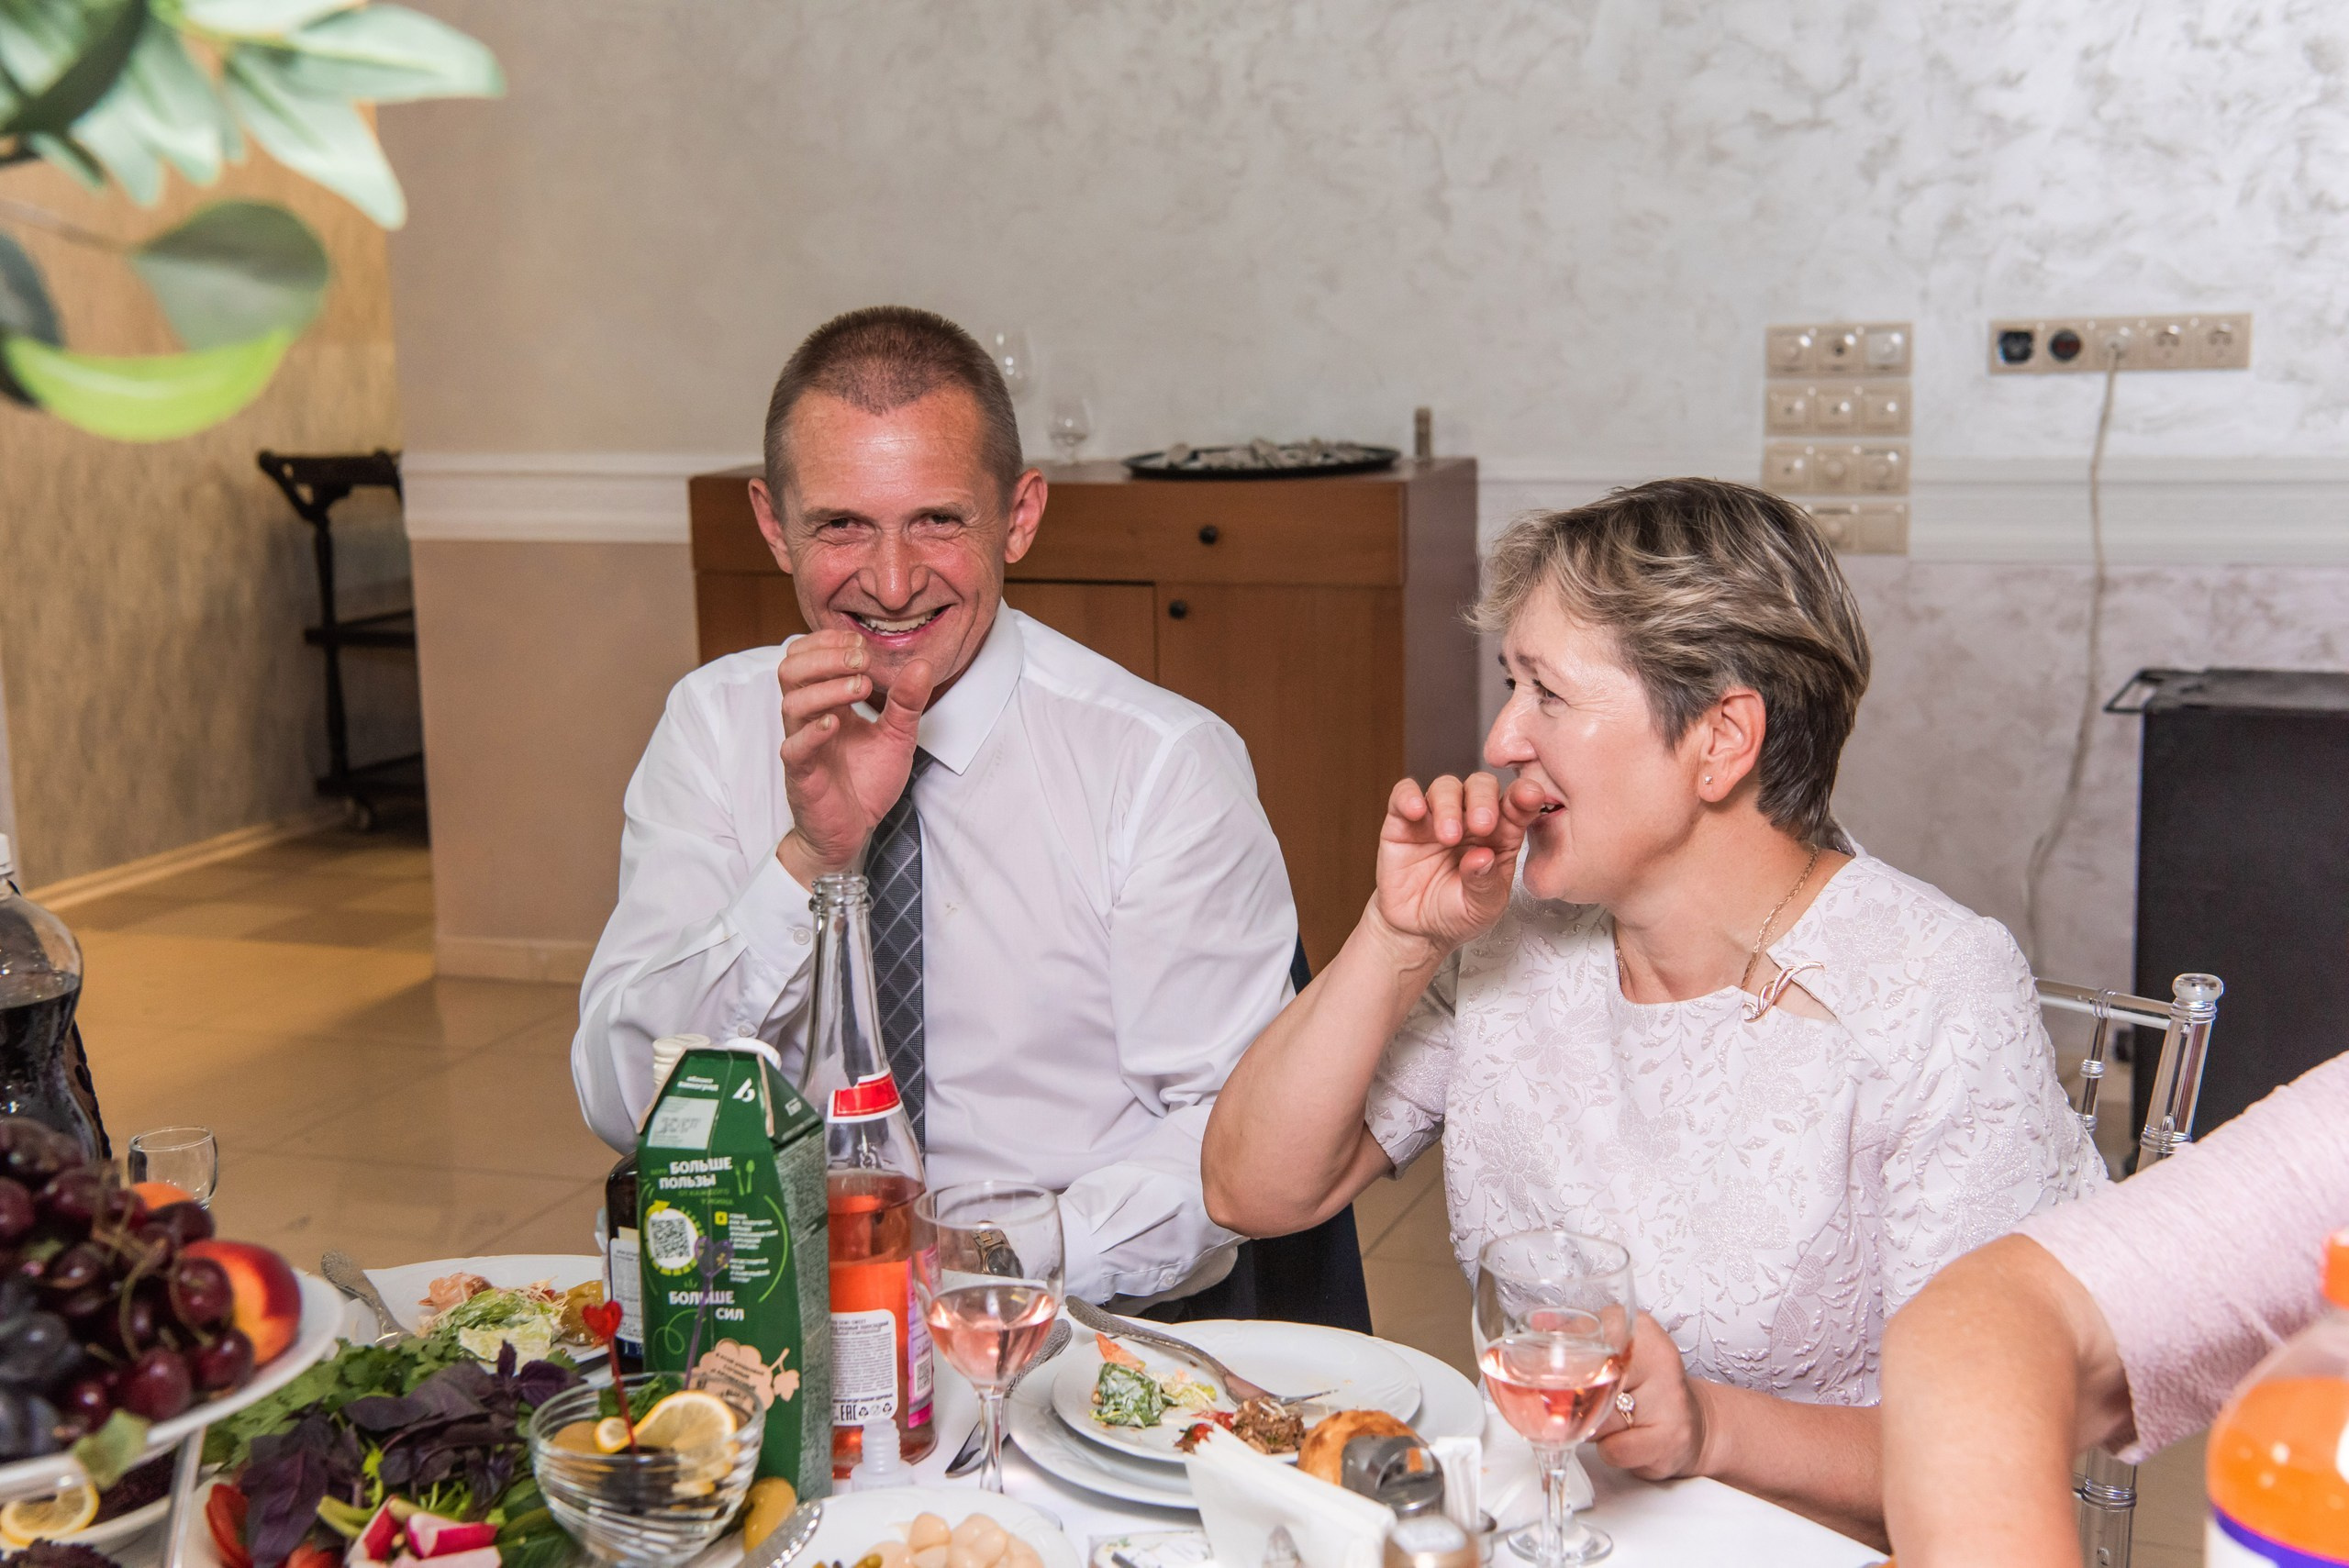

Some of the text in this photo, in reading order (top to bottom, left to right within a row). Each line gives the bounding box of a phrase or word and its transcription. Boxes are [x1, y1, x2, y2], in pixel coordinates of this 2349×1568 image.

[670, 1156, 733, 1174] БОЛЬШЕ
[659, 1173, 716, 1190] ПОЛЬЗЫ
[716, 1307, 744, 1321] СИЛ
